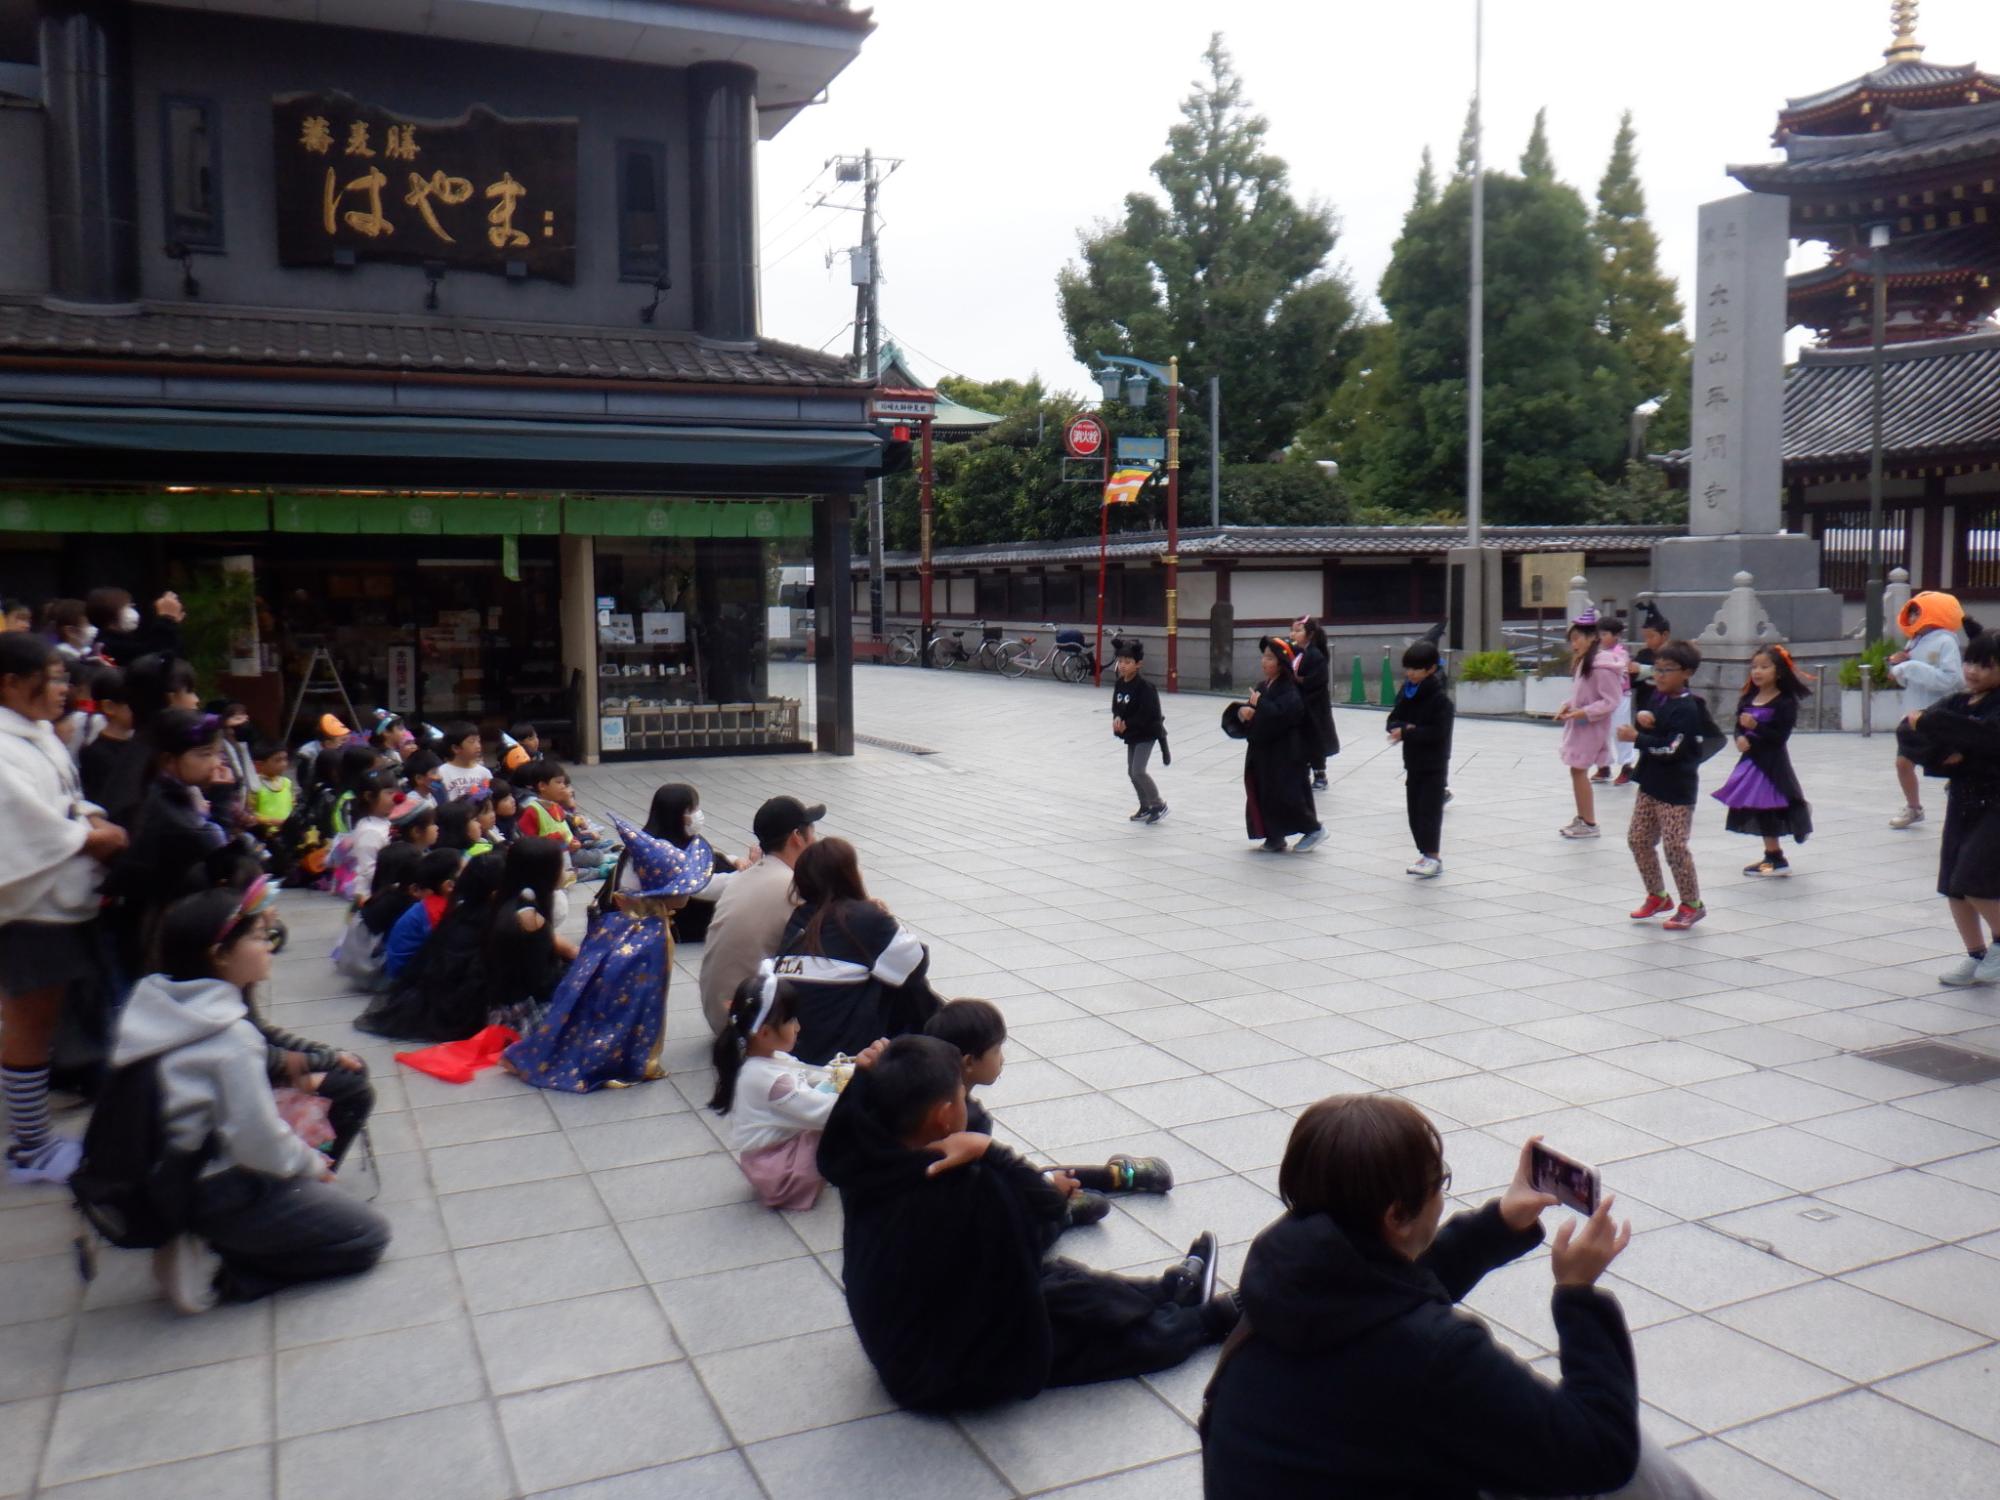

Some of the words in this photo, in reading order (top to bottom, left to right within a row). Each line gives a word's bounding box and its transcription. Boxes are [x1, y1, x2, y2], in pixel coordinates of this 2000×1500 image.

[323, 166, 531, 247] はやま
[1073, 430, 1099, 444] 消火栓
